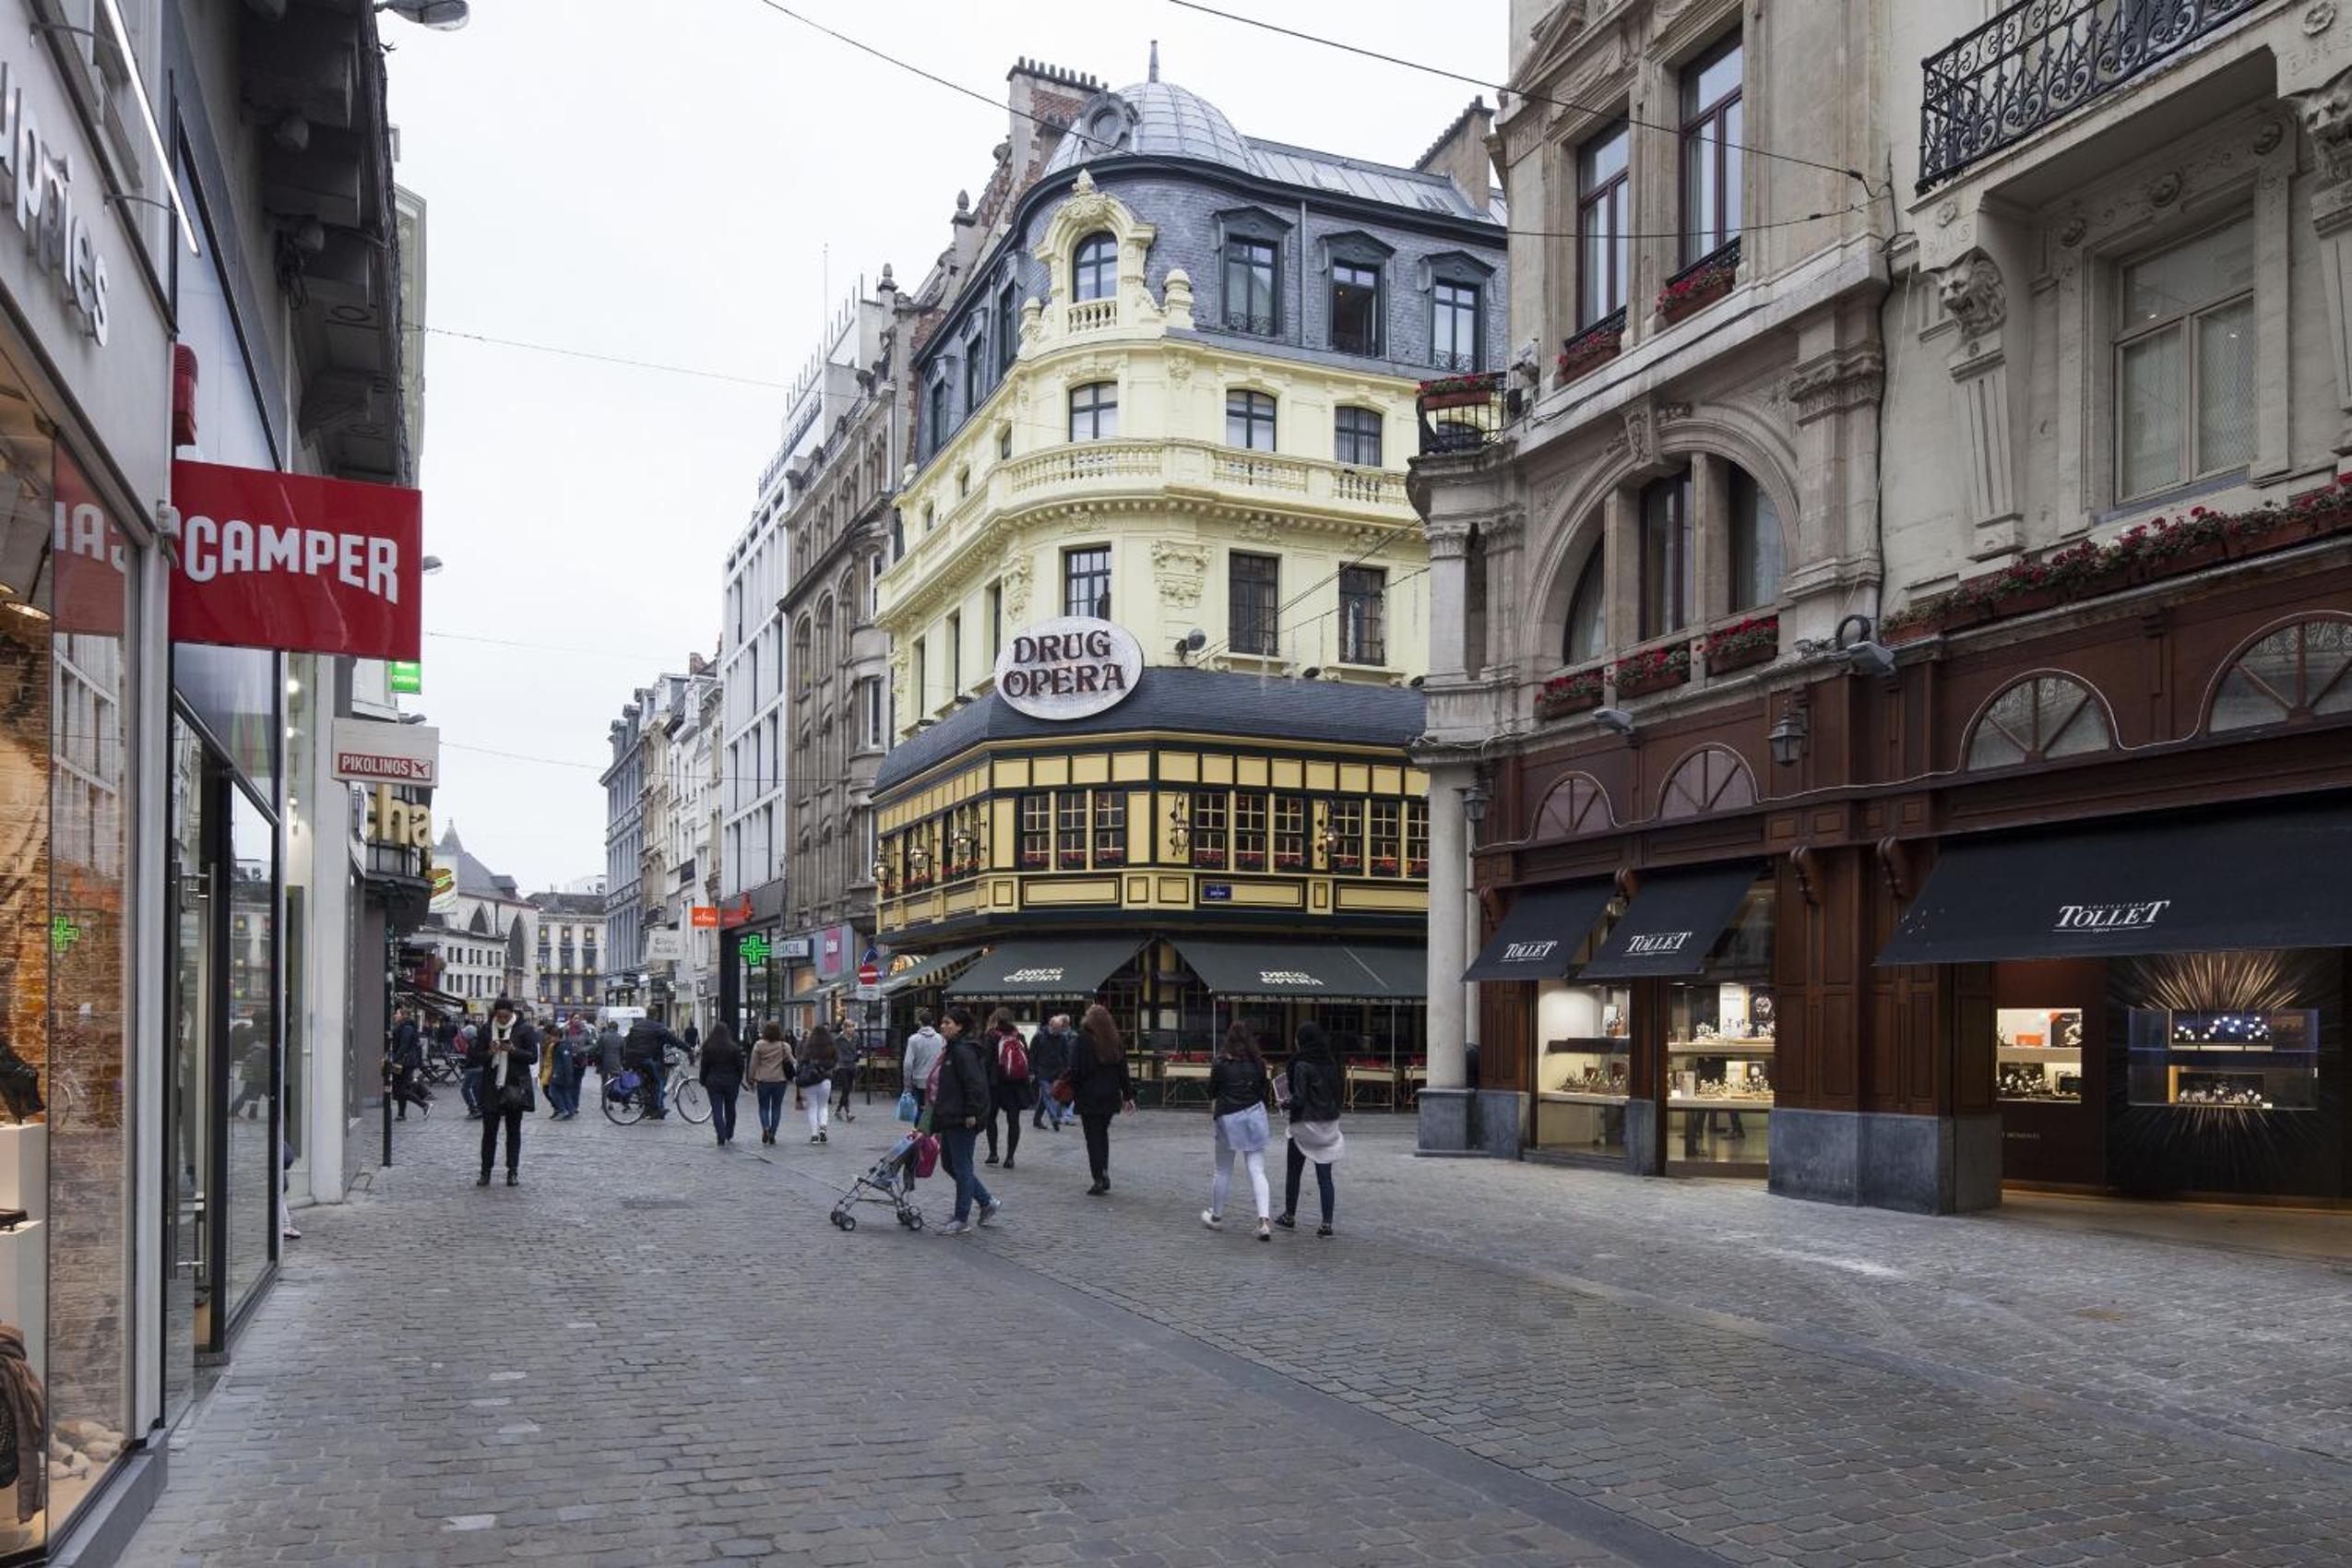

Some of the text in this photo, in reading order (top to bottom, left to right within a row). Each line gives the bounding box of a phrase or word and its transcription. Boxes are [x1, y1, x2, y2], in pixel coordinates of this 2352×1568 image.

[184, 515, 399, 605] CAMPER
[1013, 629, 1111, 664] DRUG
[1003, 662, 1126, 698] OPERA
[341, 754, 410, 776] PIKOLINOS
[2054, 899, 2171, 928] TOLLET
[1503, 940, 1559, 959] TOLLET
[1624, 931, 1693, 953] TOLLET
[1259, 970, 1310, 979] DRUG
